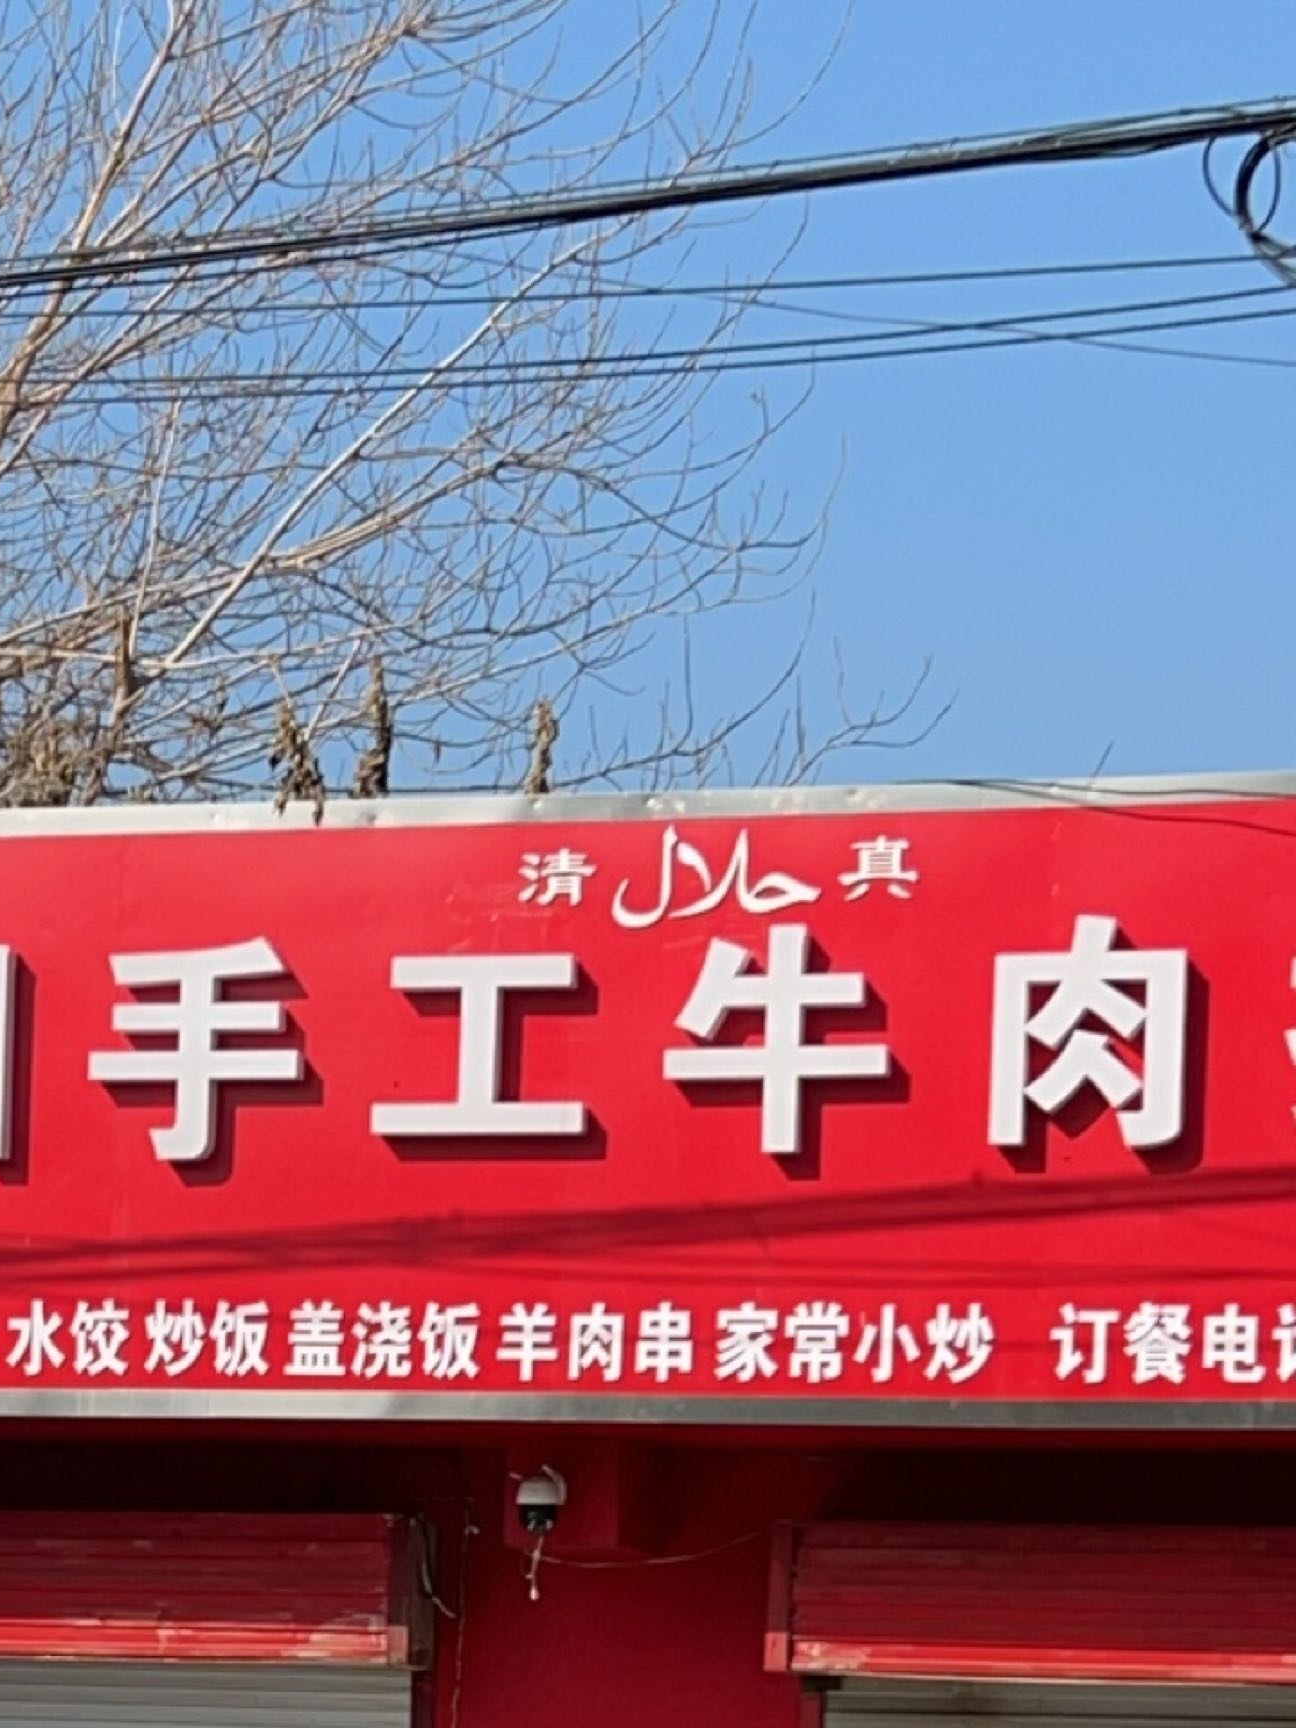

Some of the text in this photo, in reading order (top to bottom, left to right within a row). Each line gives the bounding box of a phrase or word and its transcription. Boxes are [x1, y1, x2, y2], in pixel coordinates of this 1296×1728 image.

[517, 847, 597, 906] 清
[611, 824, 821, 929] حلال
[837, 834, 919, 901] 真
[6, 1299, 130, 1377] 水饺
[144, 1299, 270, 1377] 炒饭
[284, 1299, 480, 1379] 盖浇饭
[496, 1301, 693, 1382] 羊肉串
[714, 1301, 995, 1384] 家常小炒
